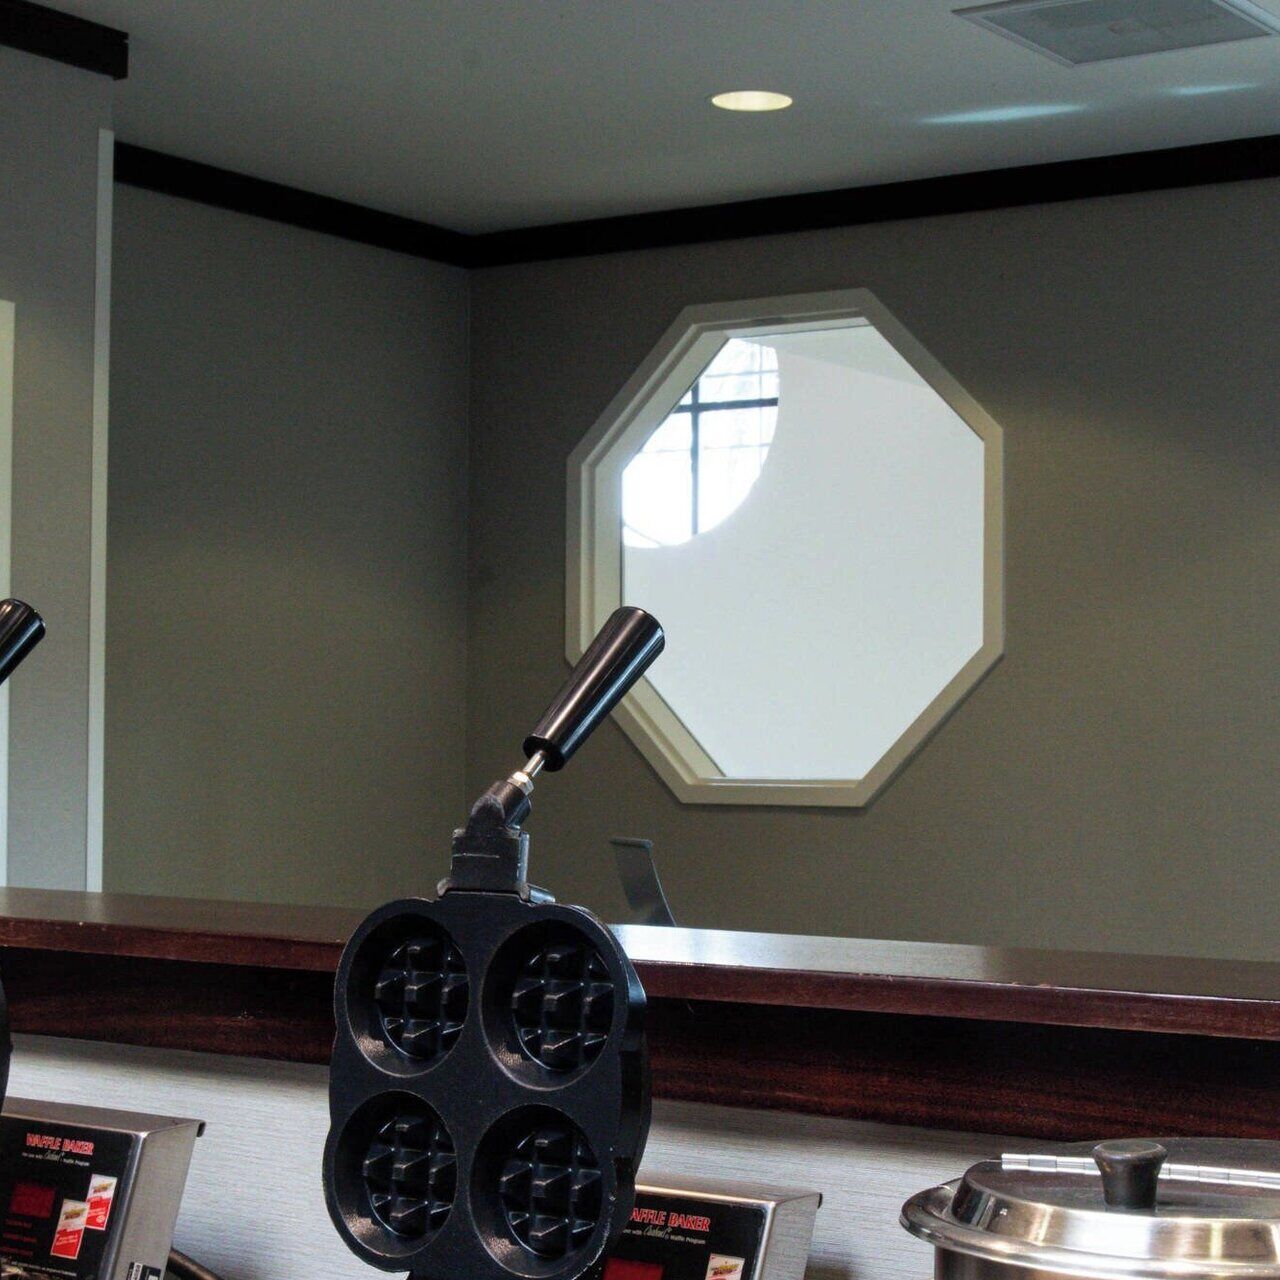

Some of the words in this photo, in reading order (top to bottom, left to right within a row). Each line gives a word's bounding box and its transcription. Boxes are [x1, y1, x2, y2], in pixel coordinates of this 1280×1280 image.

[26, 1132, 61, 1150] WAFFLE
[62, 1138, 95, 1155] BAKER
[629, 1207, 667, 1225] AFFLE
[667, 1212, 711, 1232] BAKER
